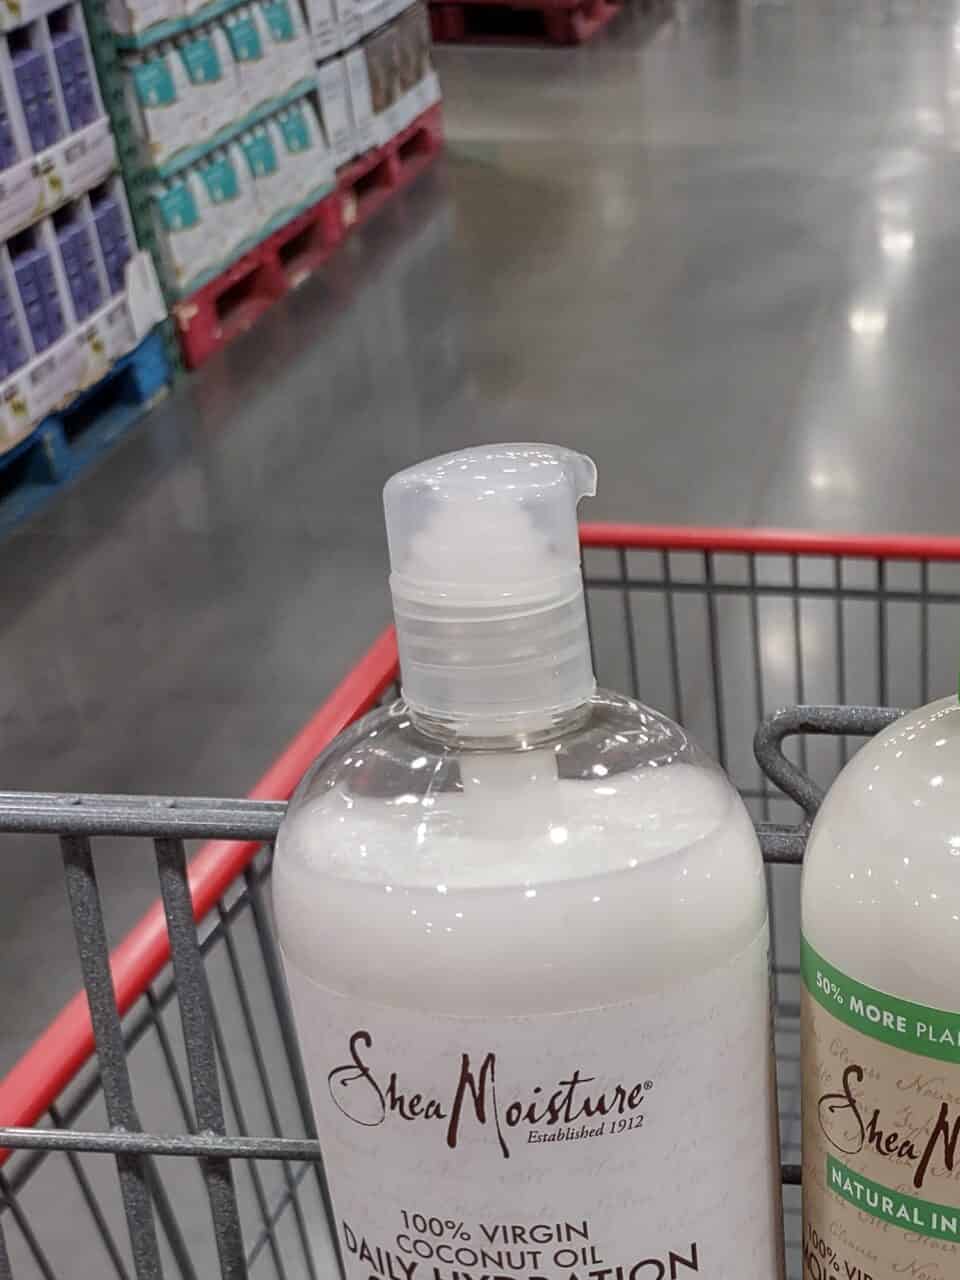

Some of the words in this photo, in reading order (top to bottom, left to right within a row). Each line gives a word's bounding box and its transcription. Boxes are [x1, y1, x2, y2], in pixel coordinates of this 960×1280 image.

[815, 970, 844, 1005] 50%
[849, 996, 907, 1033] MORE
[527, 1119, 605, 1145] Established
[608, 1114, 644, 1135] 1912
[831, 1168, 923, 1226] NATURAL
[400, 1210, 471, 1242] 100%
[480, 1221, 590, 1245] VIRGIN
[808, 1223, 840, 1272] 100%
[396, 1234, 543, 1270] COCONUT
[553, 1246, 603, 1269] OIL
